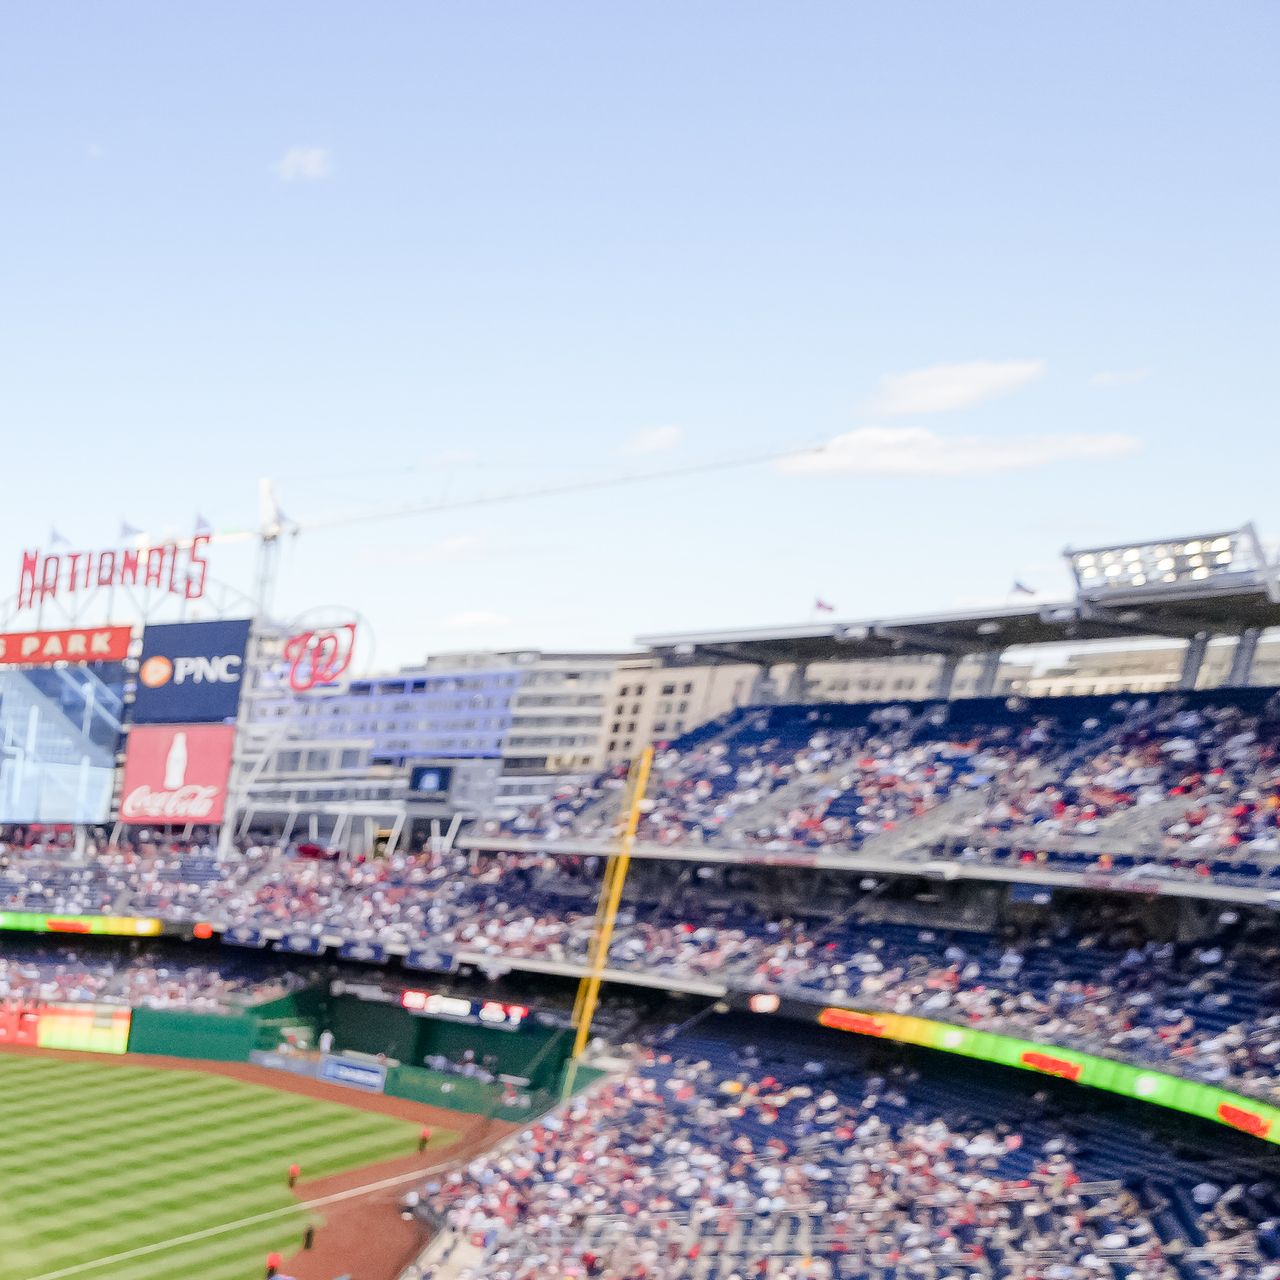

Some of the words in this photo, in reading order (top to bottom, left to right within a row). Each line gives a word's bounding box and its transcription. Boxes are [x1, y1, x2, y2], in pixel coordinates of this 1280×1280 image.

[17, 535, 210, 612] NATIONALS
[20, 631, 113, 658] PARK
[173, 653, 242, 686] PNC
